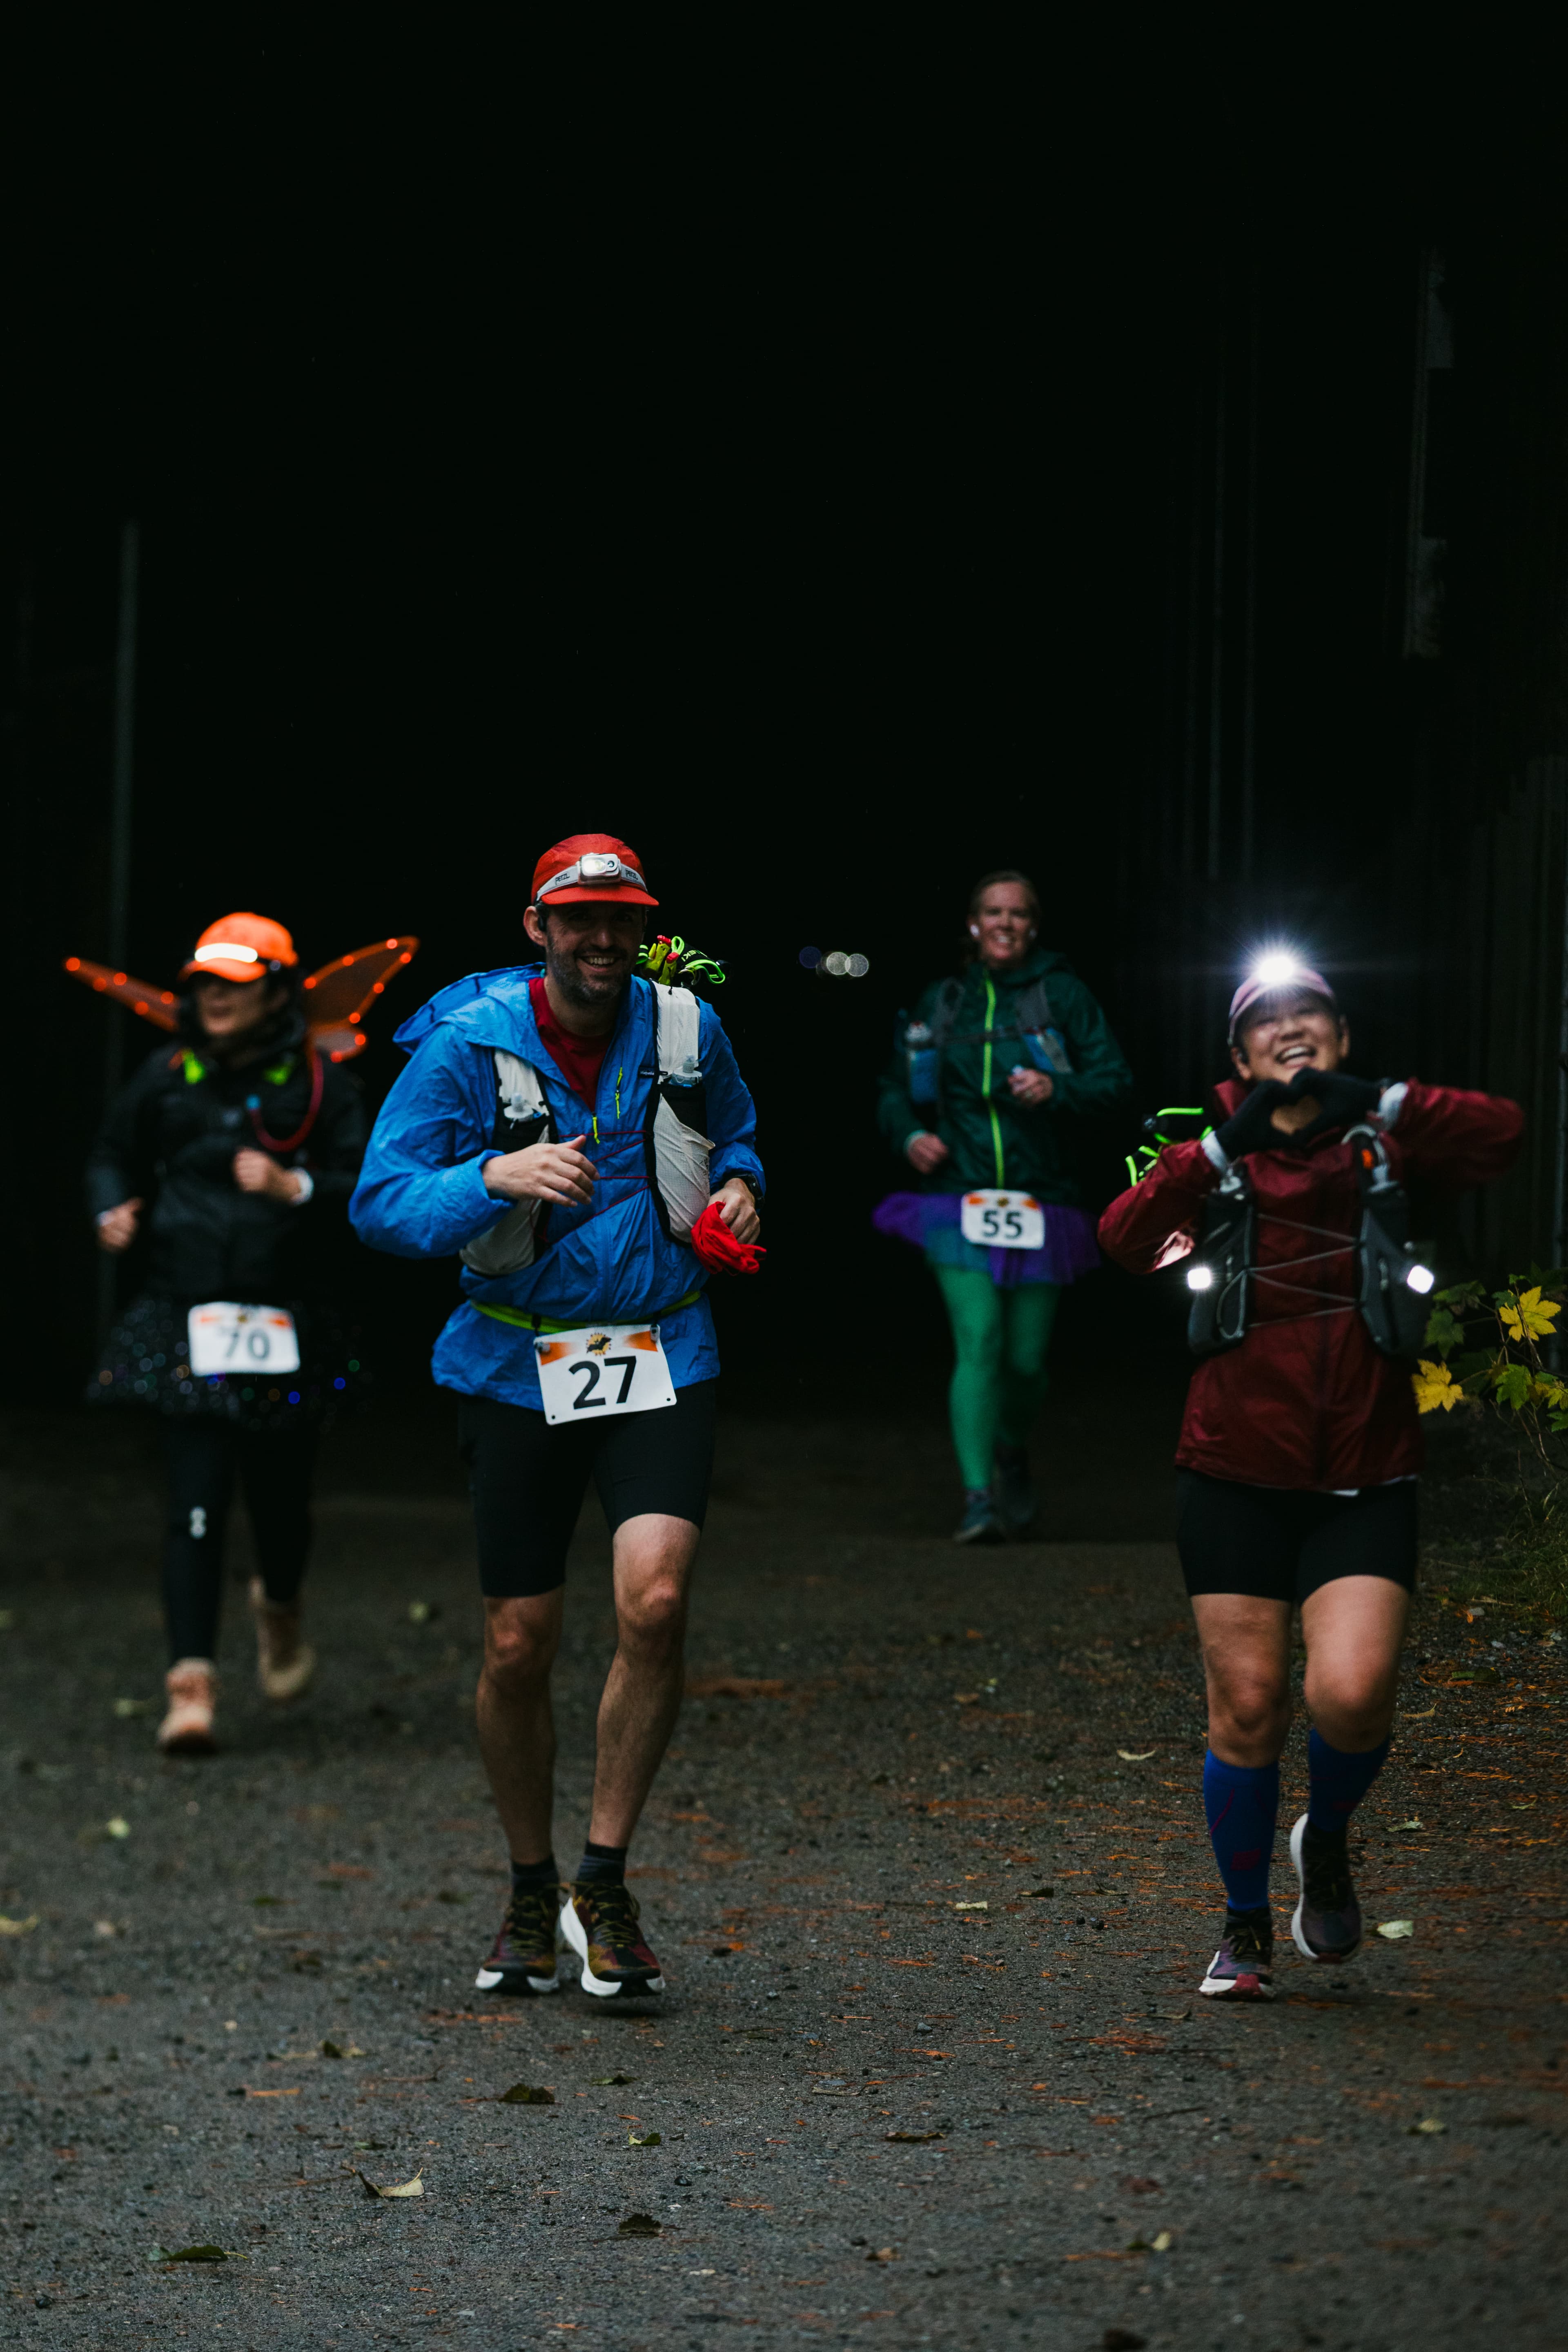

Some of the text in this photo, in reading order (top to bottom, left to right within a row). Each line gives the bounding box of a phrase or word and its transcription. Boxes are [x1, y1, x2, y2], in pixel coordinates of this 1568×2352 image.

[555, 873, 570, 885] PETZL
[983, 1210, 1022, 1240] 55
[217, 1327, 270, 1361] 70
[568, 1355, 637, 1410] 27
